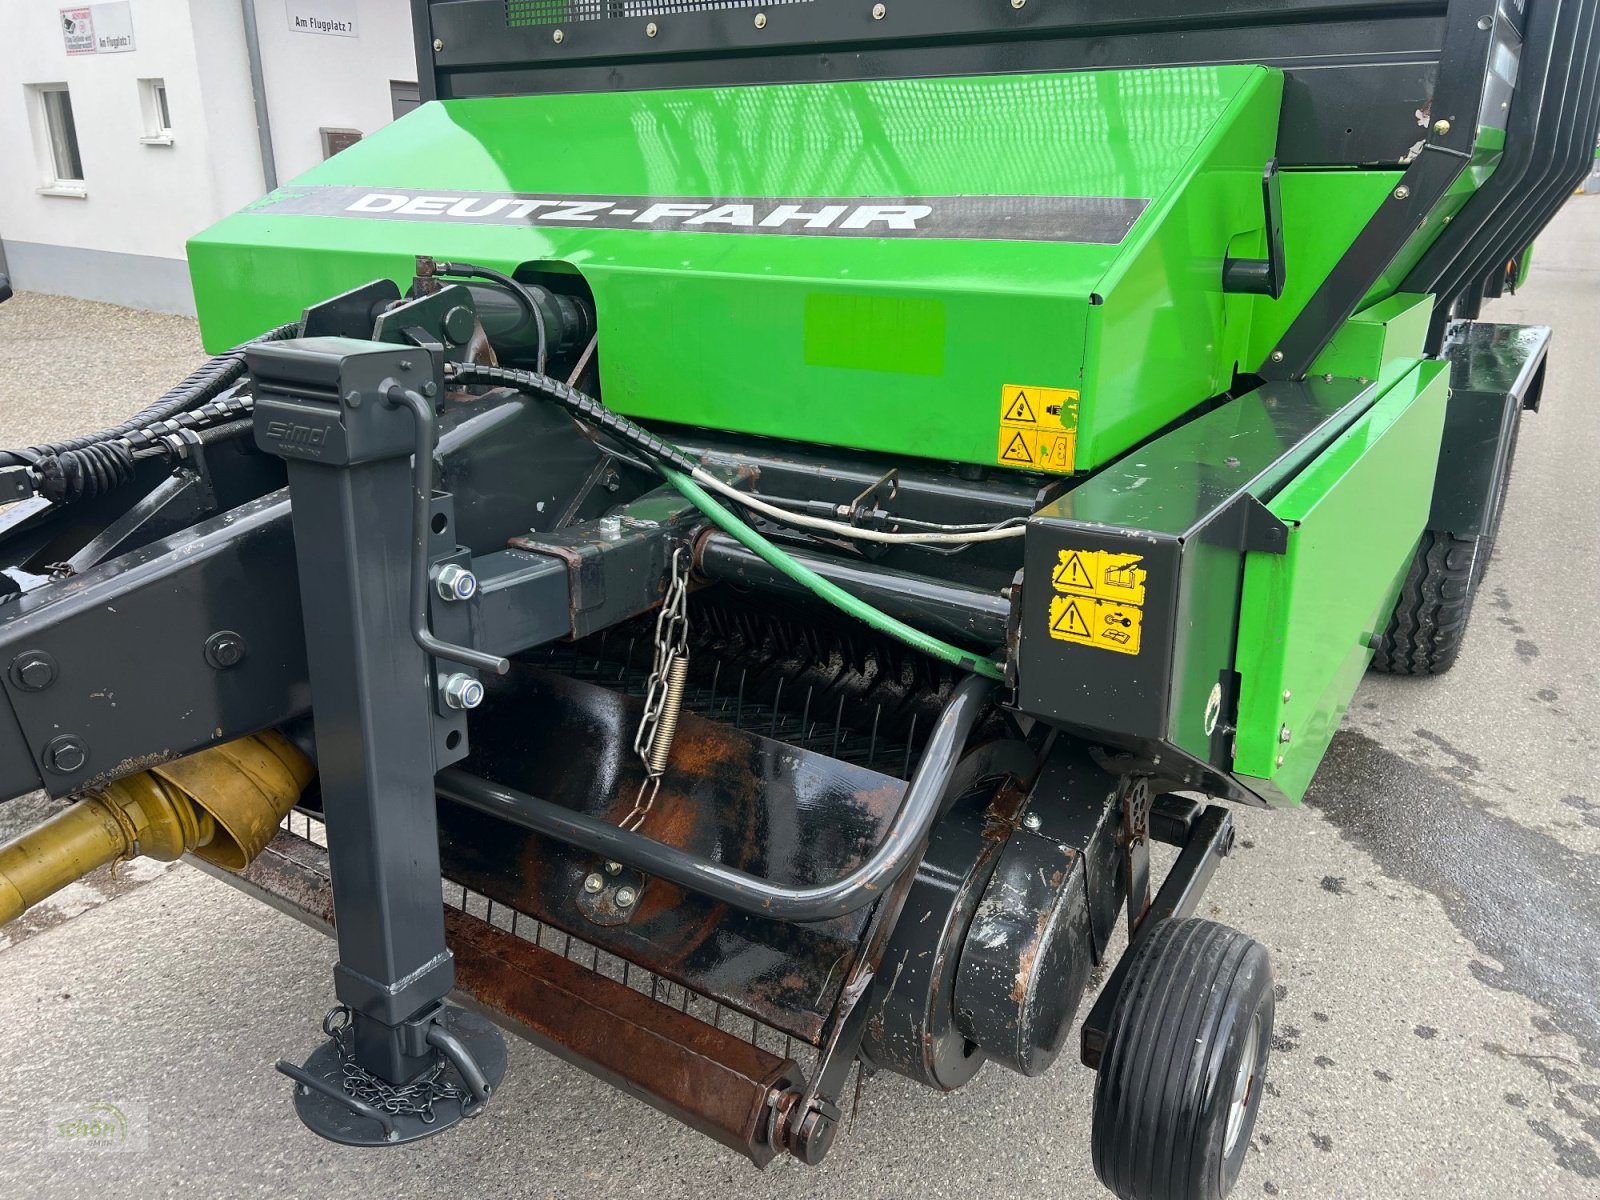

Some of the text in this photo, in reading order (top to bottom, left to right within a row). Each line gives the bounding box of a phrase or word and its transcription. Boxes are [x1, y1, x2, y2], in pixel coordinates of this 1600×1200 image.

[295, 16, 352, 32] Am Flugplatz 7
[344, 193, 932, 230] DEUTZ-FAHR
